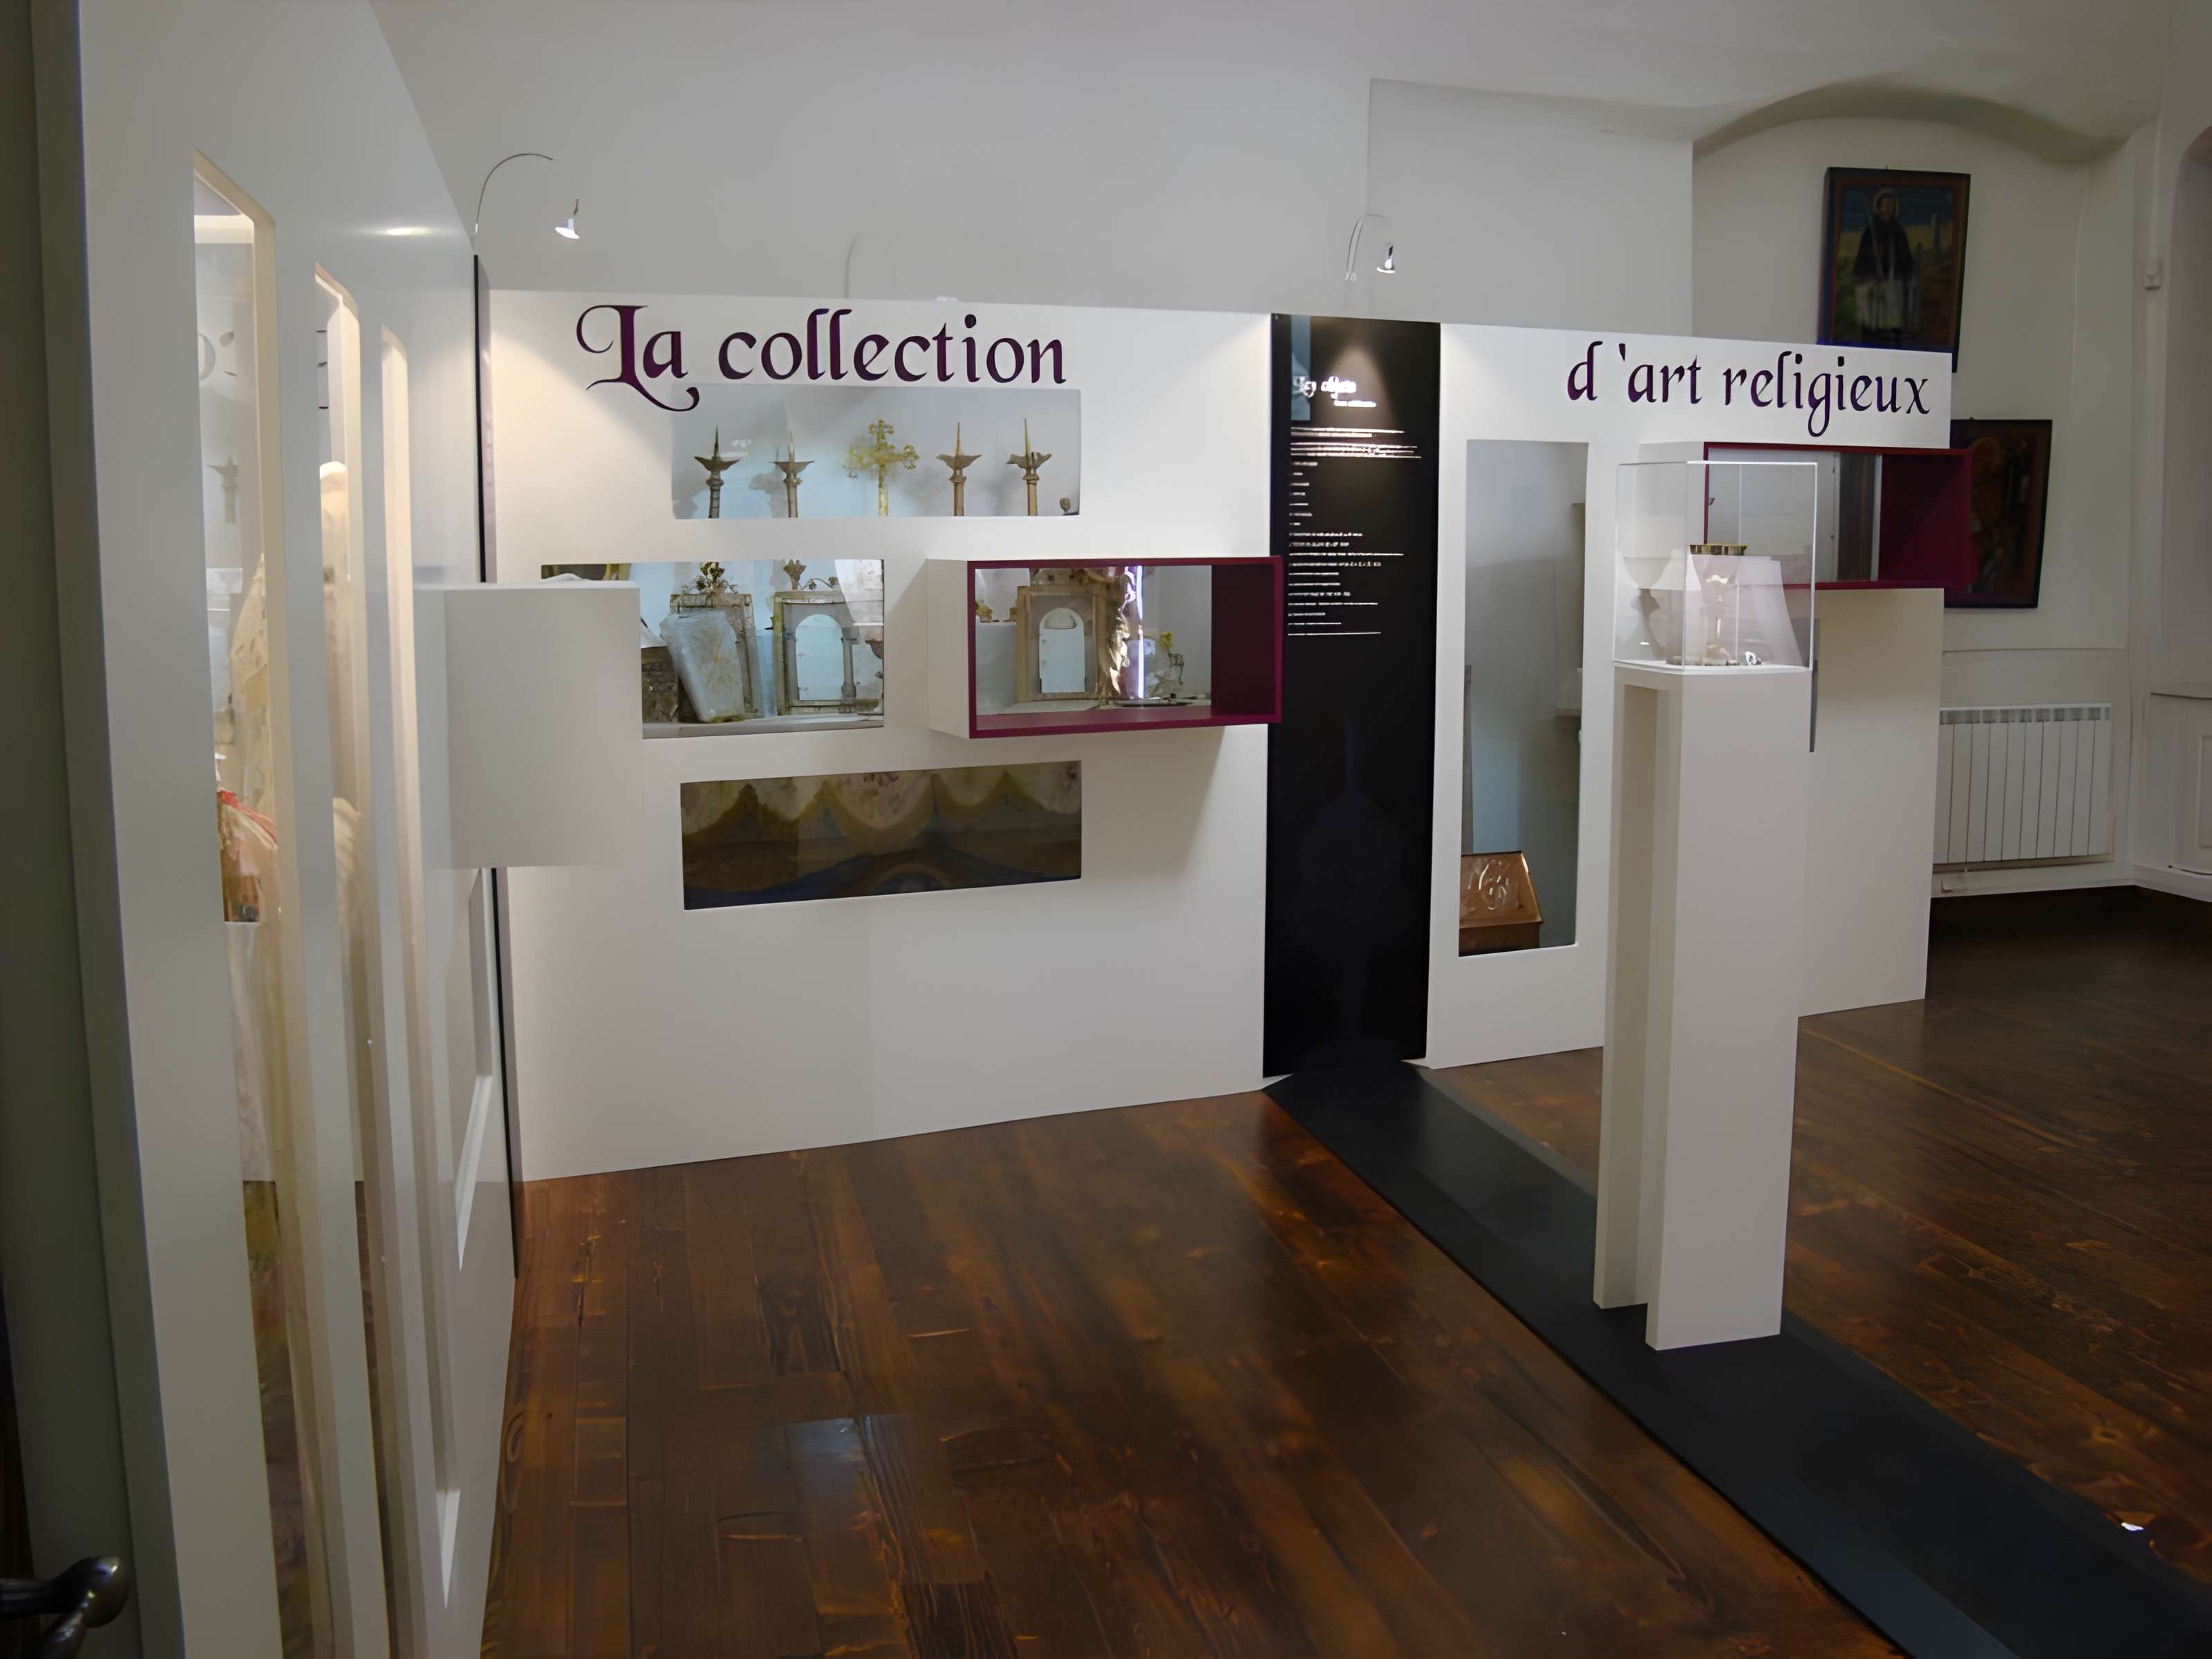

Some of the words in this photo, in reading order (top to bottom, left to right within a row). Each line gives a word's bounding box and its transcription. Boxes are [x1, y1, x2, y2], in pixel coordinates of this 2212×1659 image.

[577, 304, 700, 412] La
[718, 308, 1067, 384] collection
[1723, 350, 1931, 438] religieux
